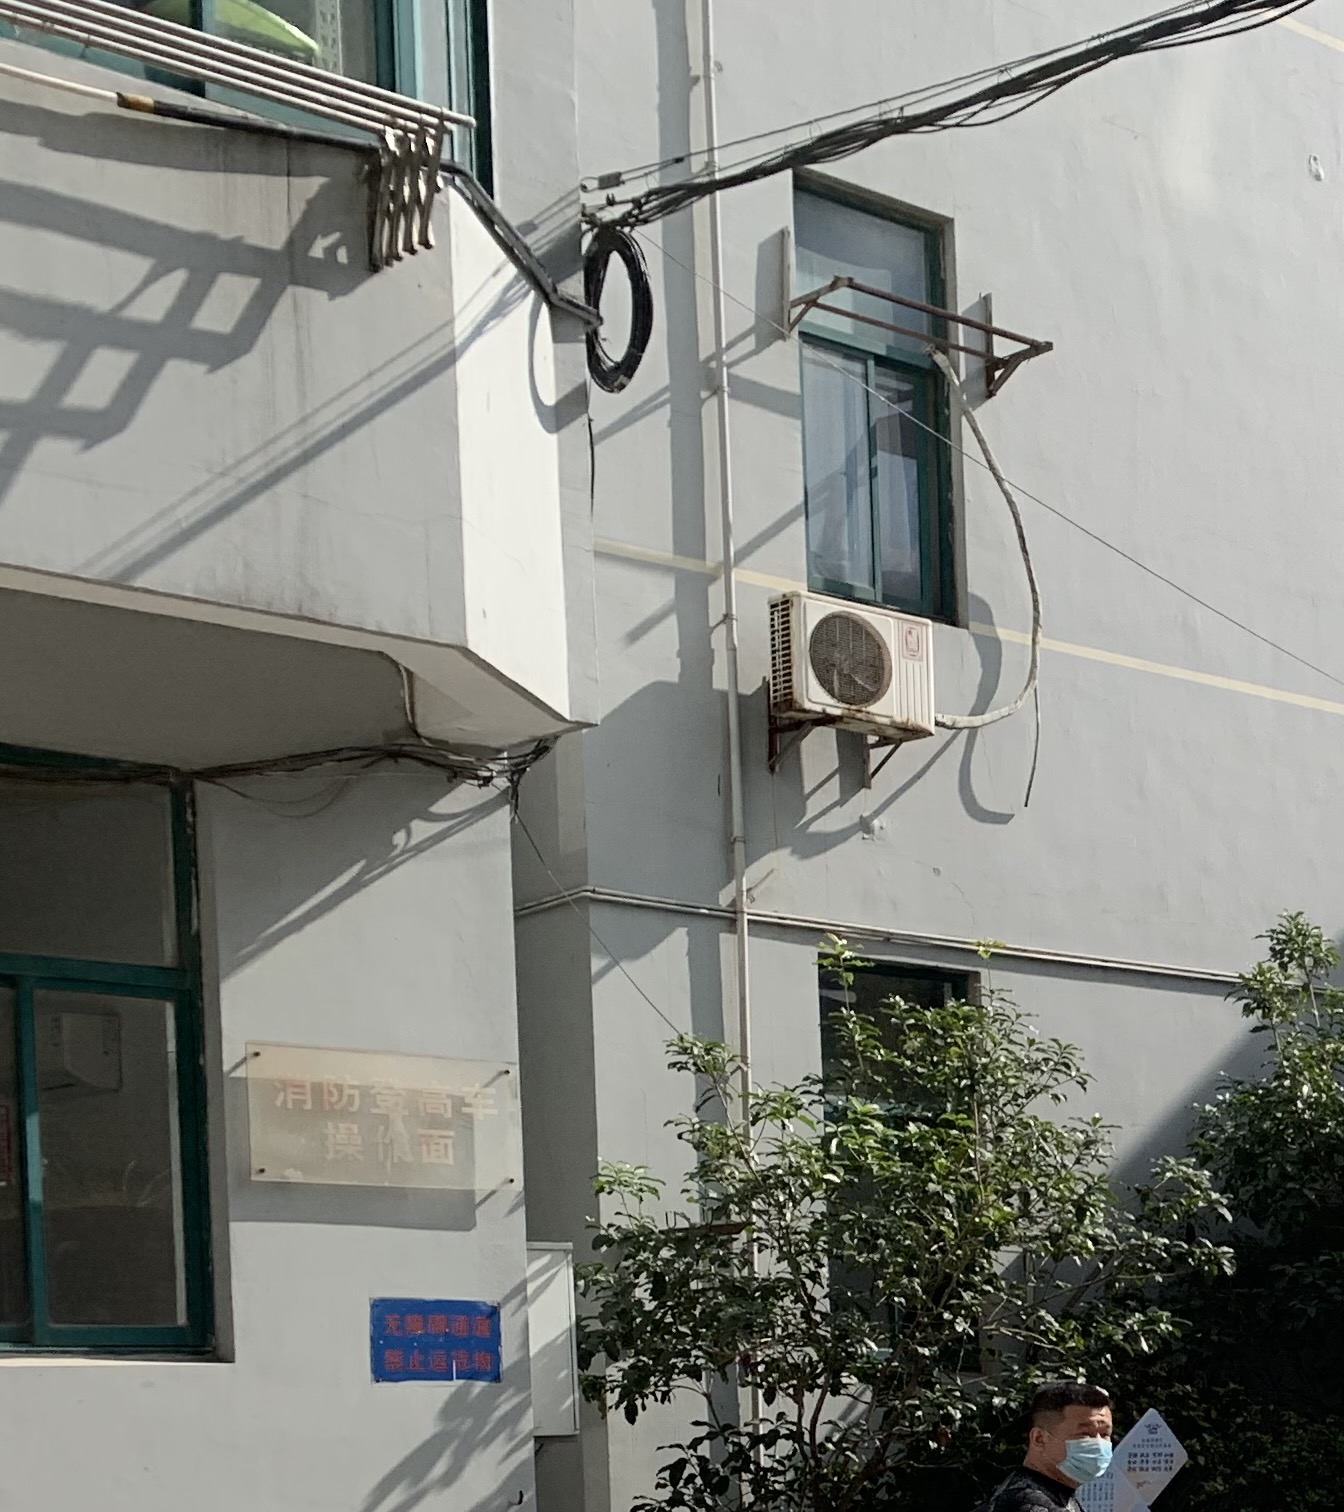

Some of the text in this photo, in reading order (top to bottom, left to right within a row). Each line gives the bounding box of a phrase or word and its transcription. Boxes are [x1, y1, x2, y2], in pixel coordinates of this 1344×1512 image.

[384, 1313, 492, 1338] 无障碍通道
